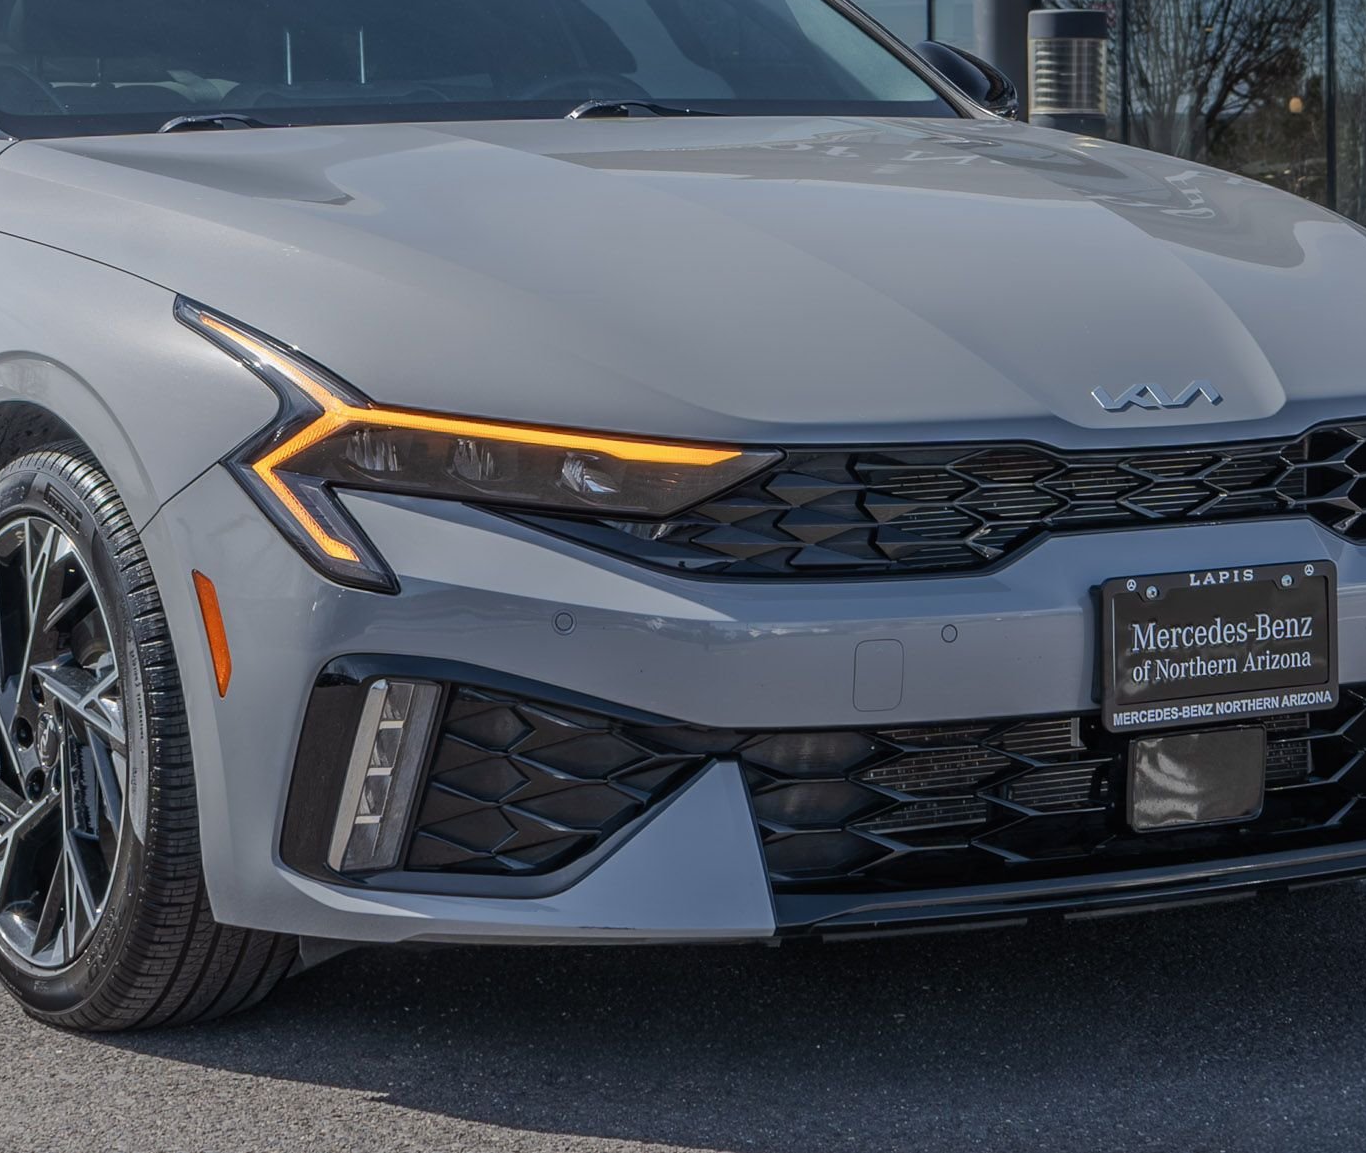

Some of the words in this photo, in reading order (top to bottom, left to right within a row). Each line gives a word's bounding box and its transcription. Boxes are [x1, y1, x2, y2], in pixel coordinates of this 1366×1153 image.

[1189, 569, 1254, 586] LAPIS
[1131, 613, 1313, 651] Mercedes-Benz
[1133, 660, 1151, 682] of
[1155, 656, 1237, 680] Northern
[1243, 650, 1311, 673] Arizona
[1113, 703, 1214, 726] MERCEDES-BENZ
[1216, 696, 1279, 715] NORTHERN
[1281, 691, 1333, 707] ARIZONA
